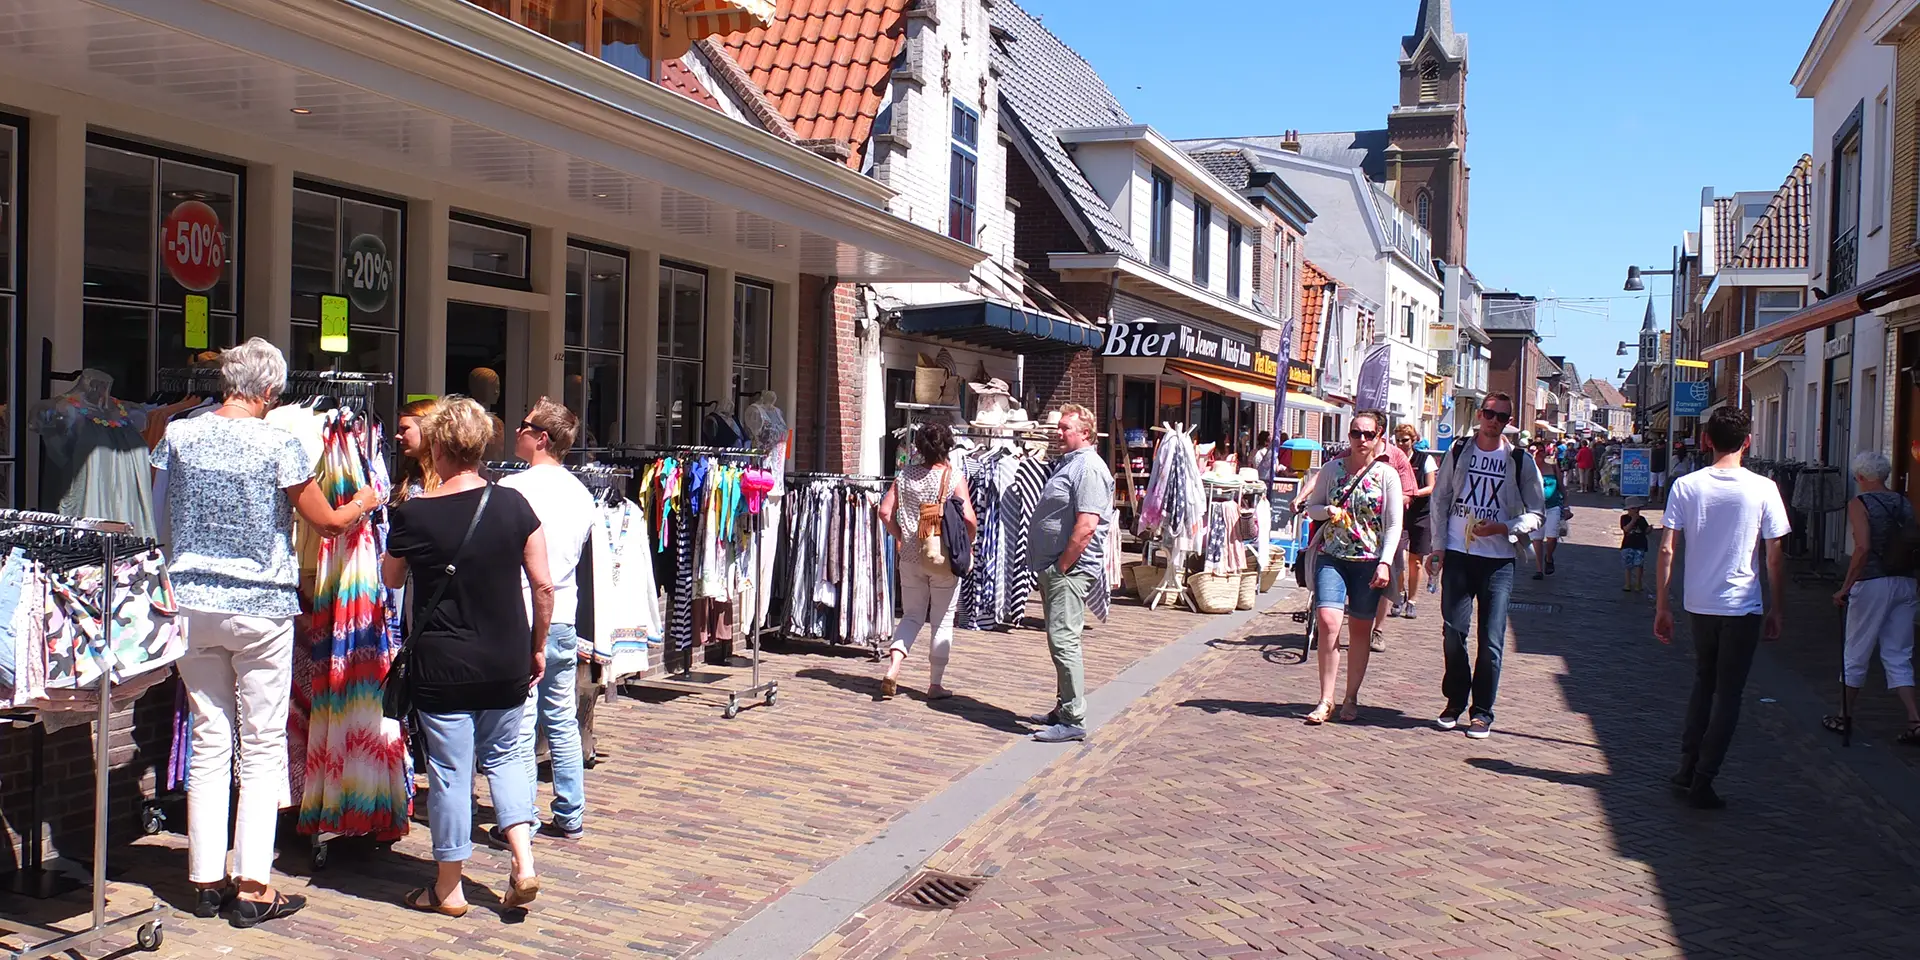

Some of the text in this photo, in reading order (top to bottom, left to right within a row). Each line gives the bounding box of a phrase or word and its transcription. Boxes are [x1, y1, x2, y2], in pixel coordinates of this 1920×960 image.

[168, 221, 221, 267] -50%
[347, 251, 388, 291] -20%
[1101, 323, 1176, 356] Bier
[1180, 325, 1195, 357] Wijn
[1195, 330, 1218, 358] Jenever
[1221, 338, 1240, 368] Whisky
[1474, 507, 1499, 522] YORK
